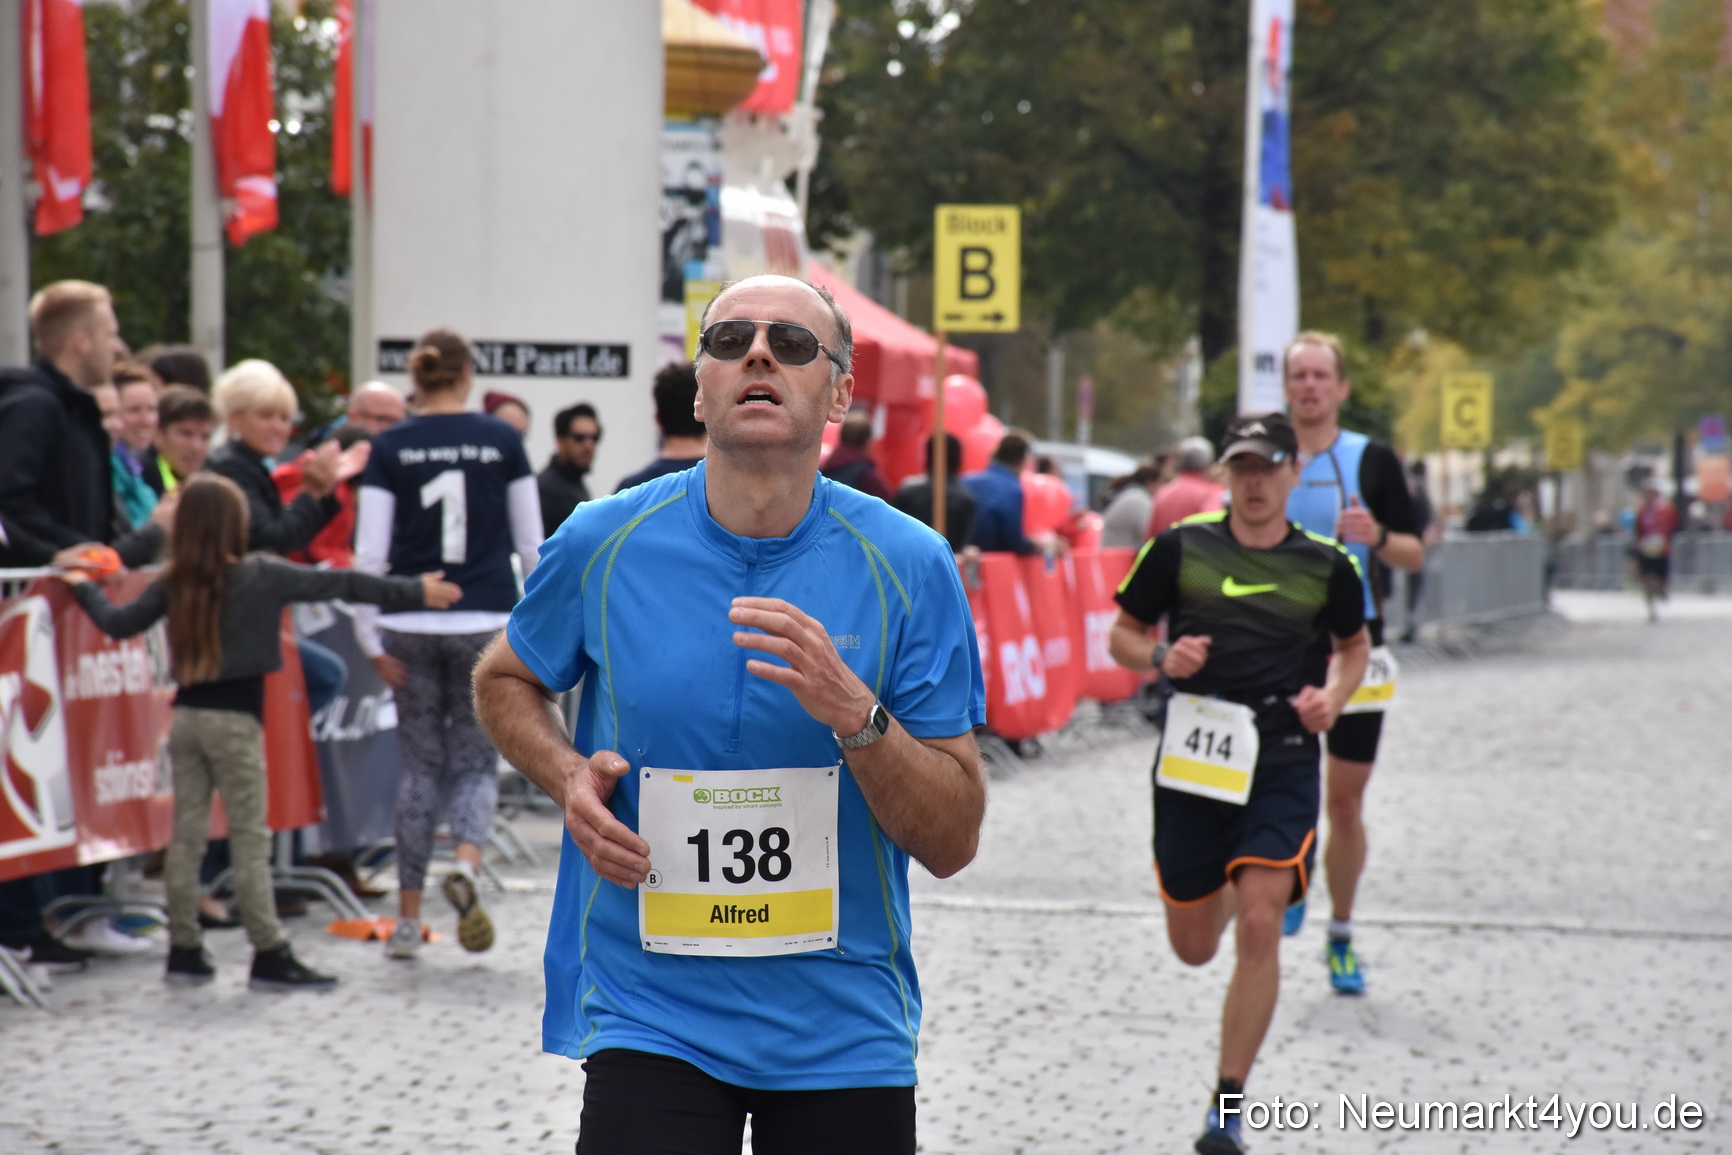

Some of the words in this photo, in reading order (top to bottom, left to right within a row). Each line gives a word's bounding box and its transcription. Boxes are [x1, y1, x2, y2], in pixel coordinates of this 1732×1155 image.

[961, 246, 996, 299] B
[1452, 395, 1478, 429] C
[397, 447, 426, 466] The
[427, 446, 460, 464] way
[461, 443, 479, 460] to
[420, 469, 467, 564] 1
[1184, 727, 1233, 761] 414
[713, 787, 781, 803] BOCK
[687, 827, 792, 884] 138
[650, 874, 657, 884] B
[709, 904, 769, 924] Alfred
